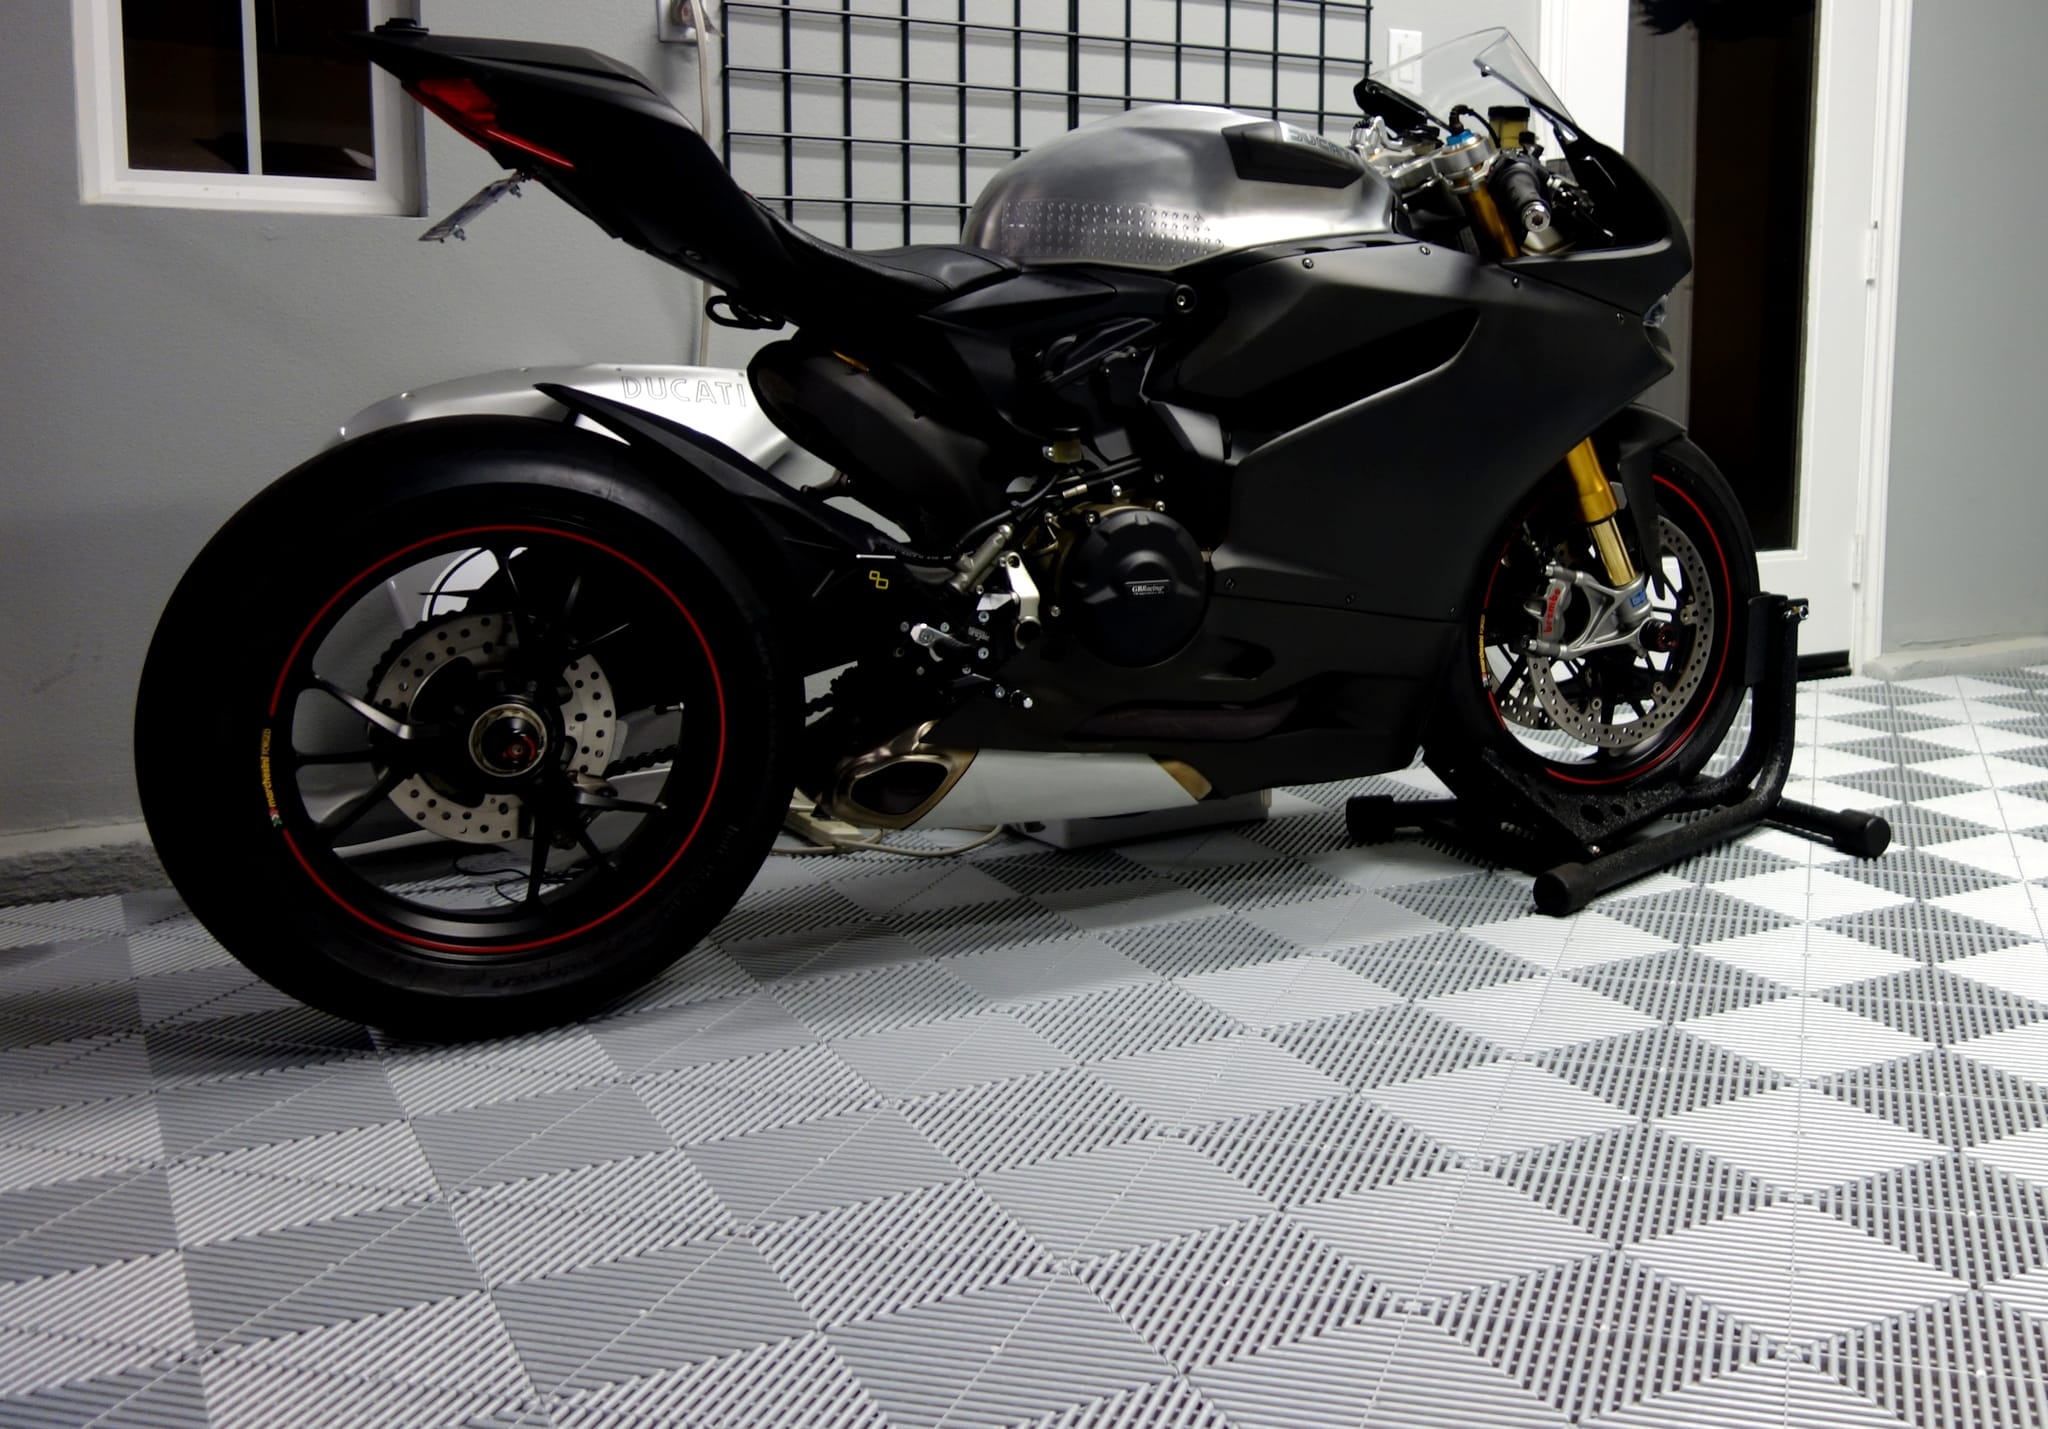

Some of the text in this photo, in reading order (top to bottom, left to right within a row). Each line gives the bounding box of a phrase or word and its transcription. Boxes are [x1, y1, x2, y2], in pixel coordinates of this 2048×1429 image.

[621, 375, 747, 407] DUCATI
[1544, 588, 1561, 634] brembo
[260, 756, 277, 808] marchesini
